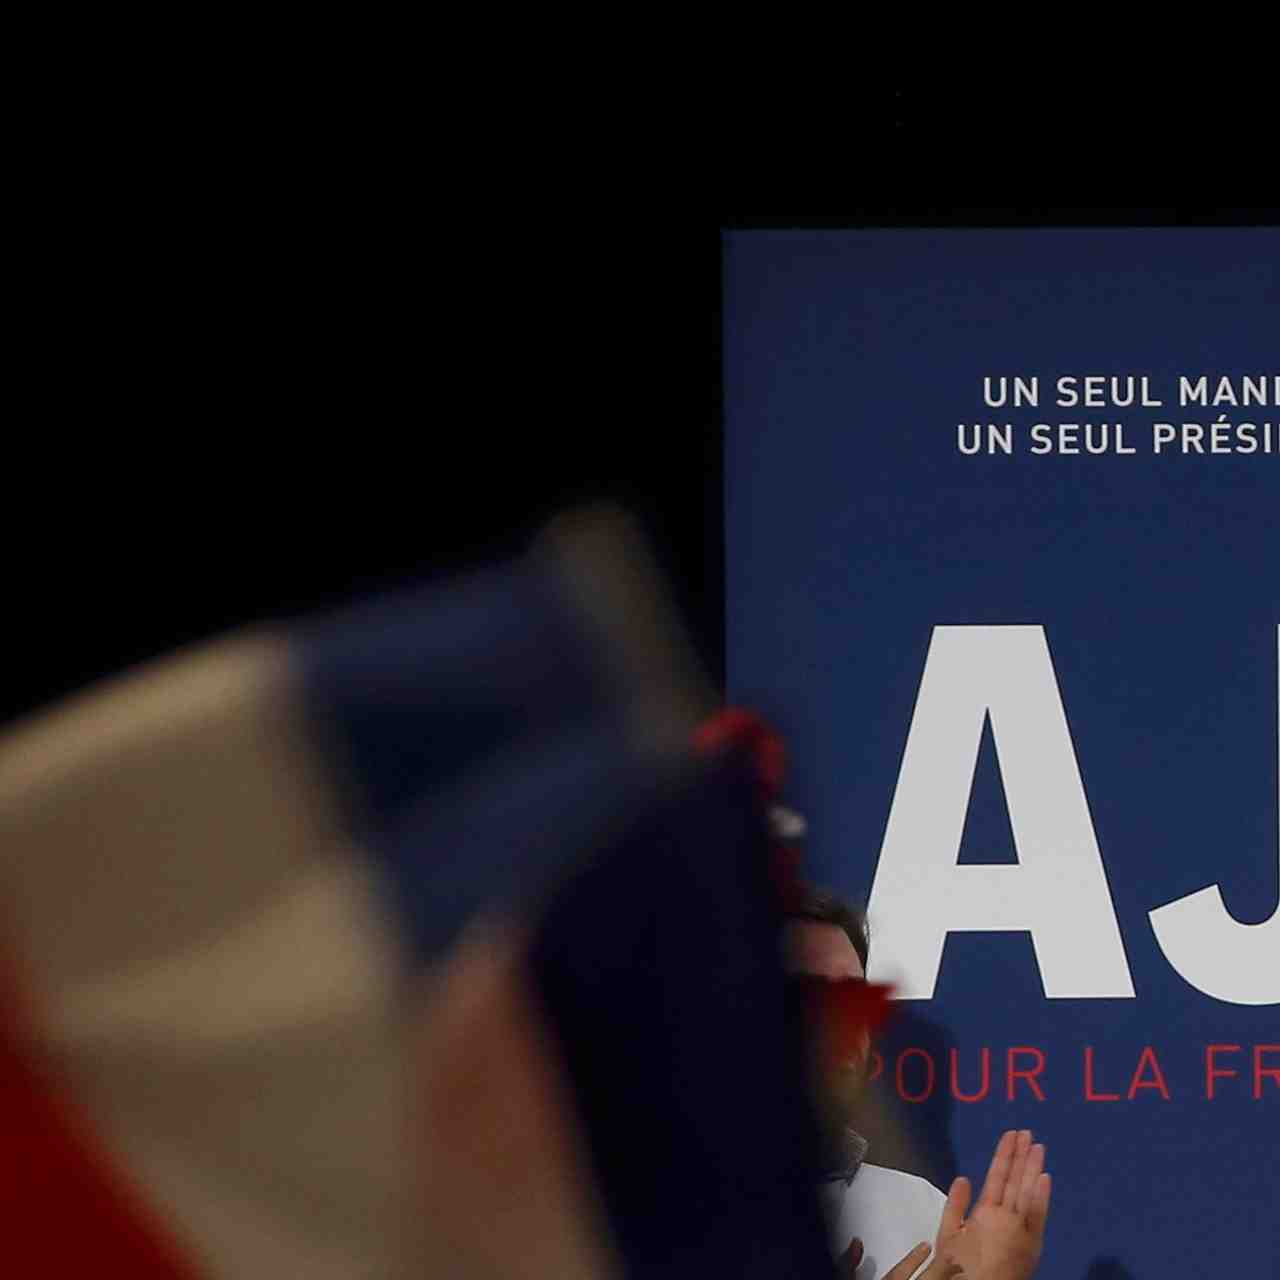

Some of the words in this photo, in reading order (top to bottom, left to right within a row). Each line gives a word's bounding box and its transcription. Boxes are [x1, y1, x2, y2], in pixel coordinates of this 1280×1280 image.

[984, 376, 1038, 407] UN
[1057, 376, 1162, 407] SEUL
[957, 424, 1012, 455] UN
[1030, 424, 1136, 455] SEUL
[1084, 1046, 1171, 1102] LA
